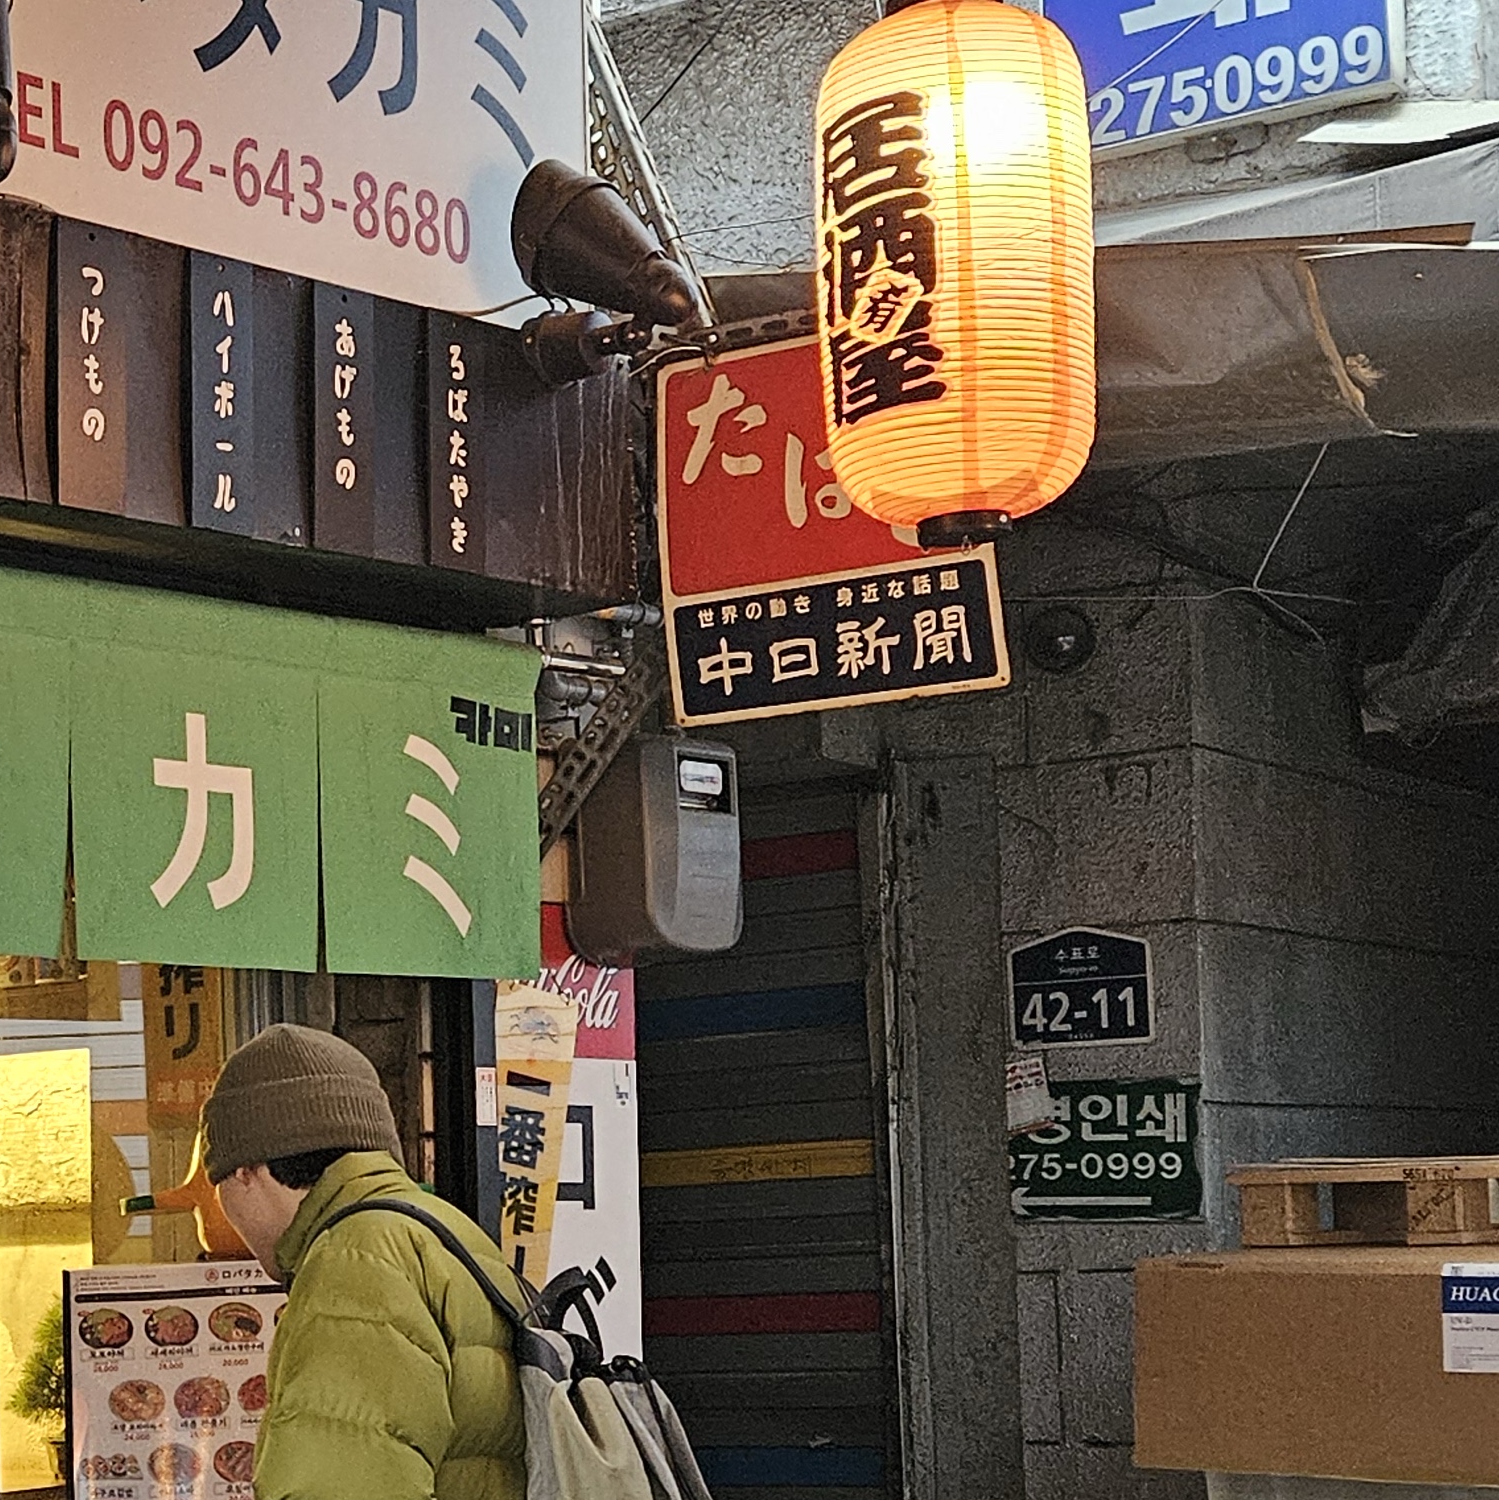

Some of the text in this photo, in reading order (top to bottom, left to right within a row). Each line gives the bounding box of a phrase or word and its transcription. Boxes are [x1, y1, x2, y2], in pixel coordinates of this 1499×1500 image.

[102, 97, 473, 266] 092-643-8680
[80, 265, 105, 443] つけもの
[211, 289, 238, 514] ハイボール
[332, 315, 358, 492] あげもの
[445, 344, 471, 555] ろばたやき
[697, 569, 961, 629] 世界の動き 身近な話題
[697, 605, 973, 697] 中日新聞
[450, 695, 533, 753] 카미
[1021, 986, 1136, 1033] 42-11
